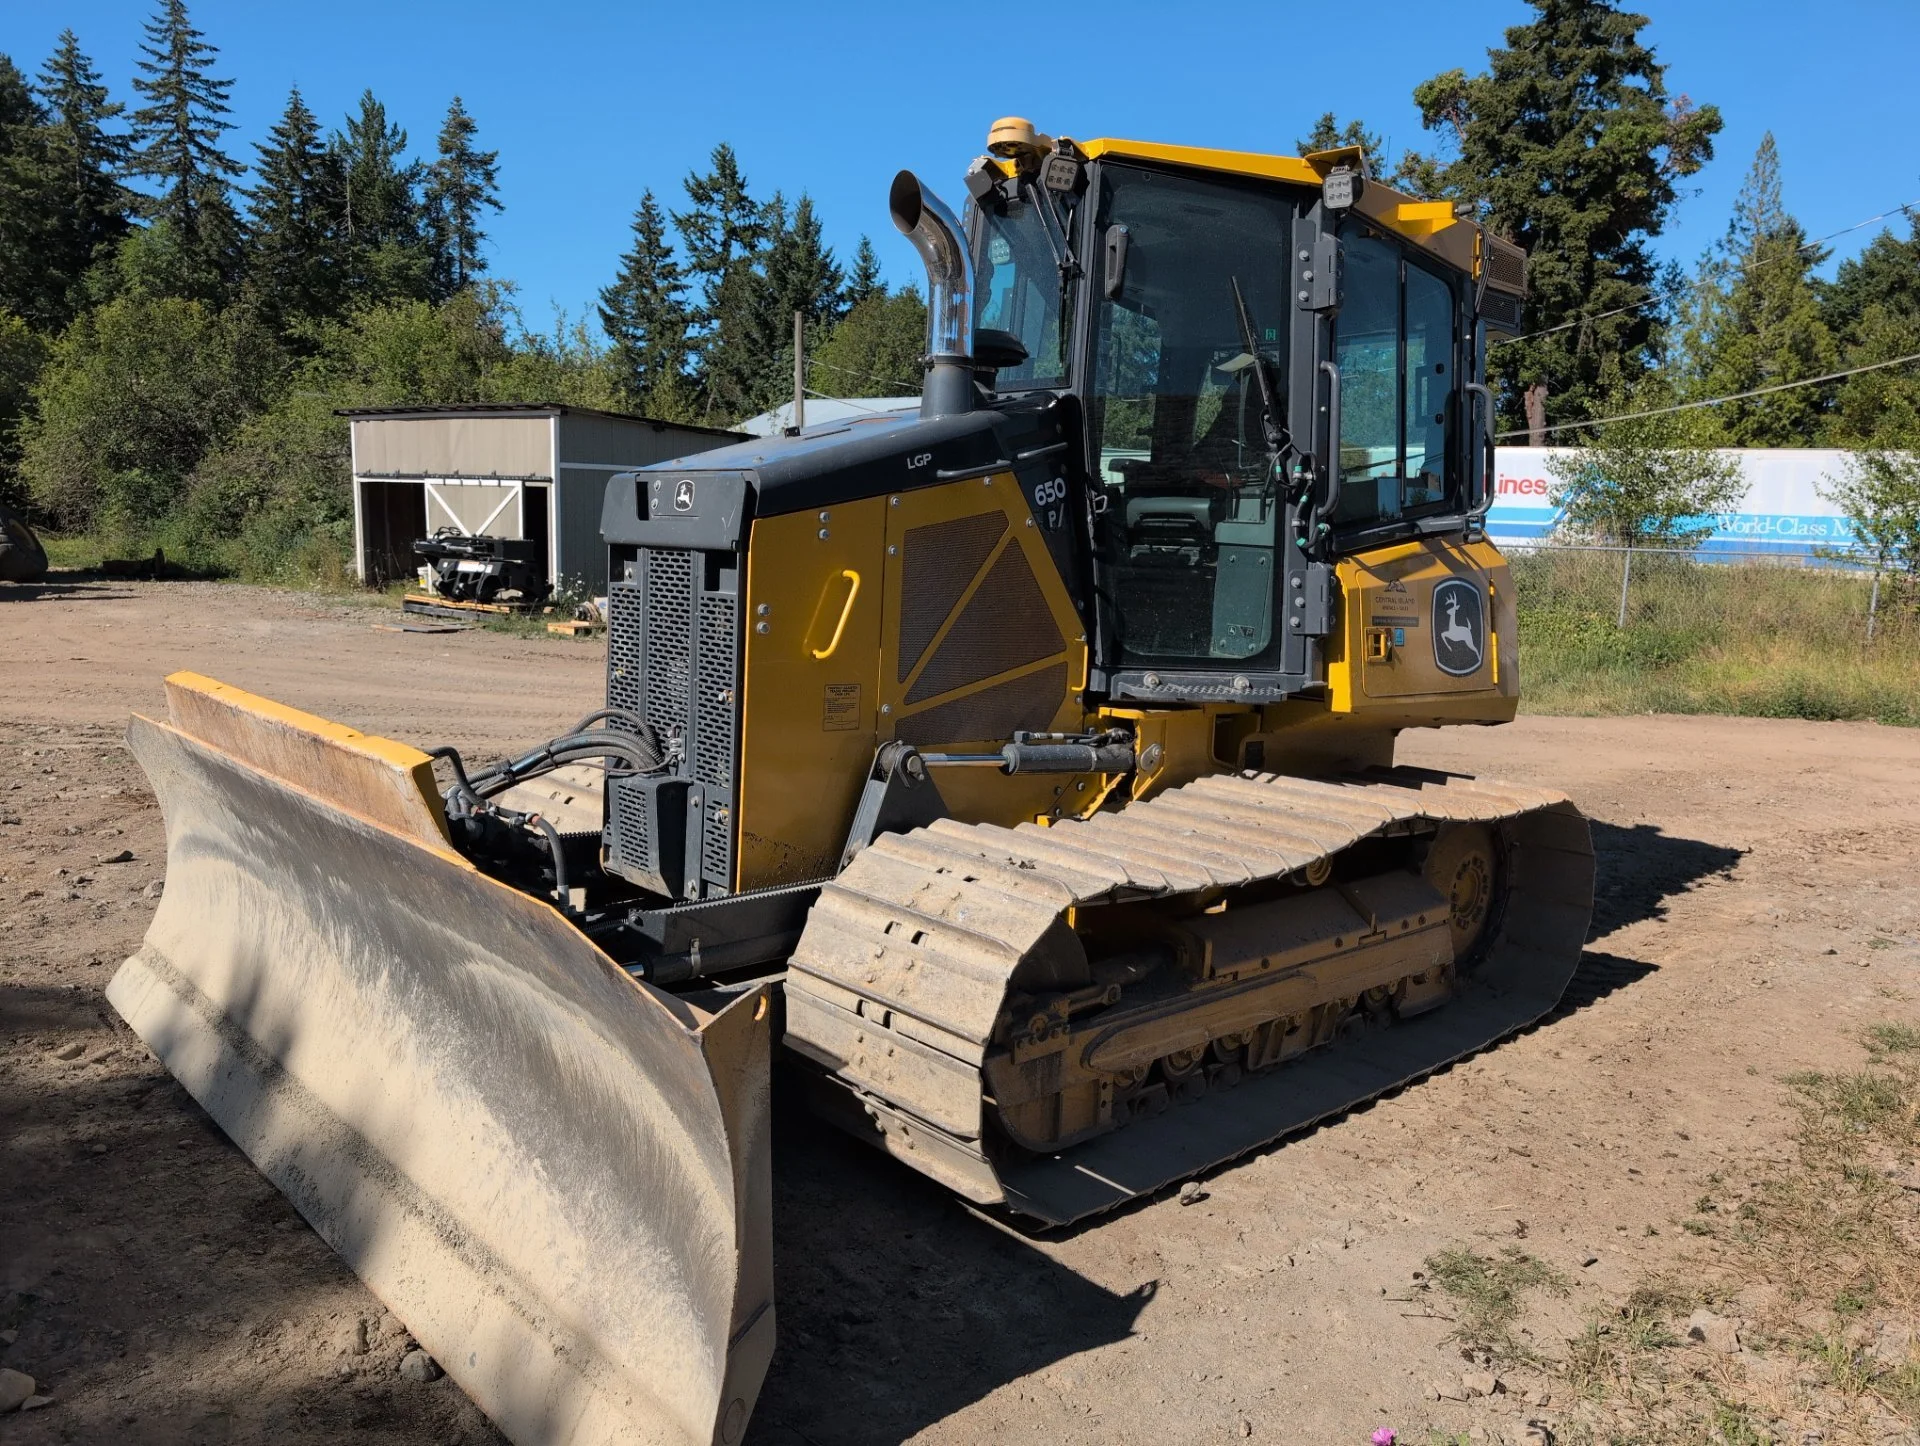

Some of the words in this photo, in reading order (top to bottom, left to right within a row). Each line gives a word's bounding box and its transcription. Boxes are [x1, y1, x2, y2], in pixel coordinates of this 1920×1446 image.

[907, 453, 931, 470] LGP
[1035, 477, 1066, 506] 650
[1717, 515, 1828, 537] World-Class
